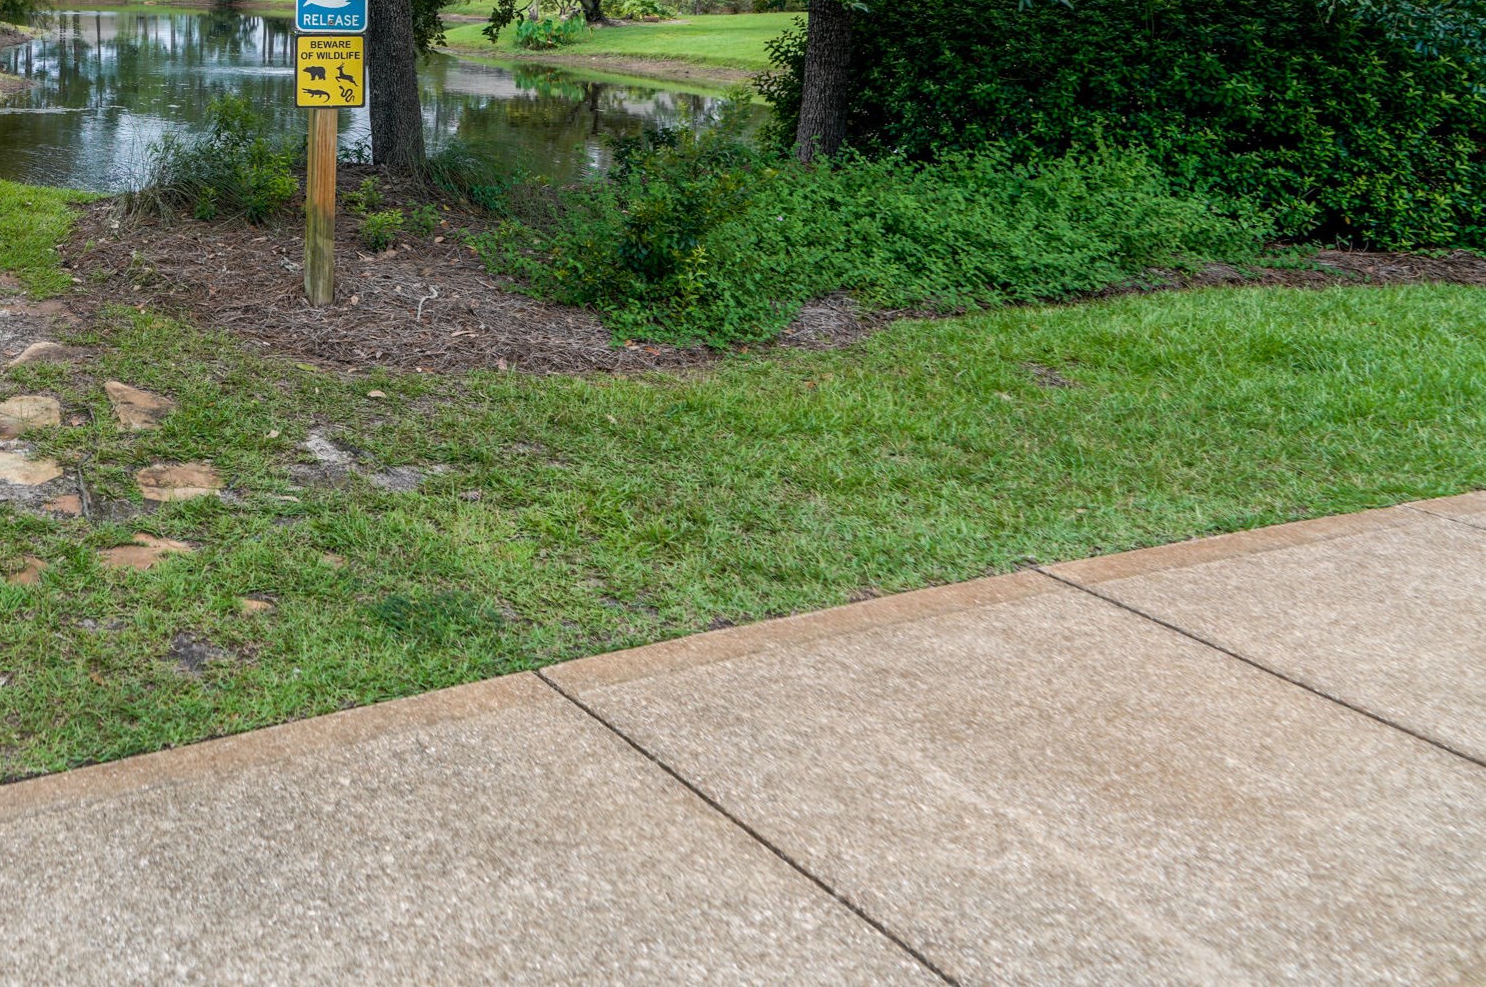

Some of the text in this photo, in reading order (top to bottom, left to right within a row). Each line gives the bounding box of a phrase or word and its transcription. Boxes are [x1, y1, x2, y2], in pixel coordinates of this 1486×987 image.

[303, 14, 360, 26] RELEASE
[310, 41, 351, 49] BEWARE
[300, 52, 361, 60] OF WILDLIFE
